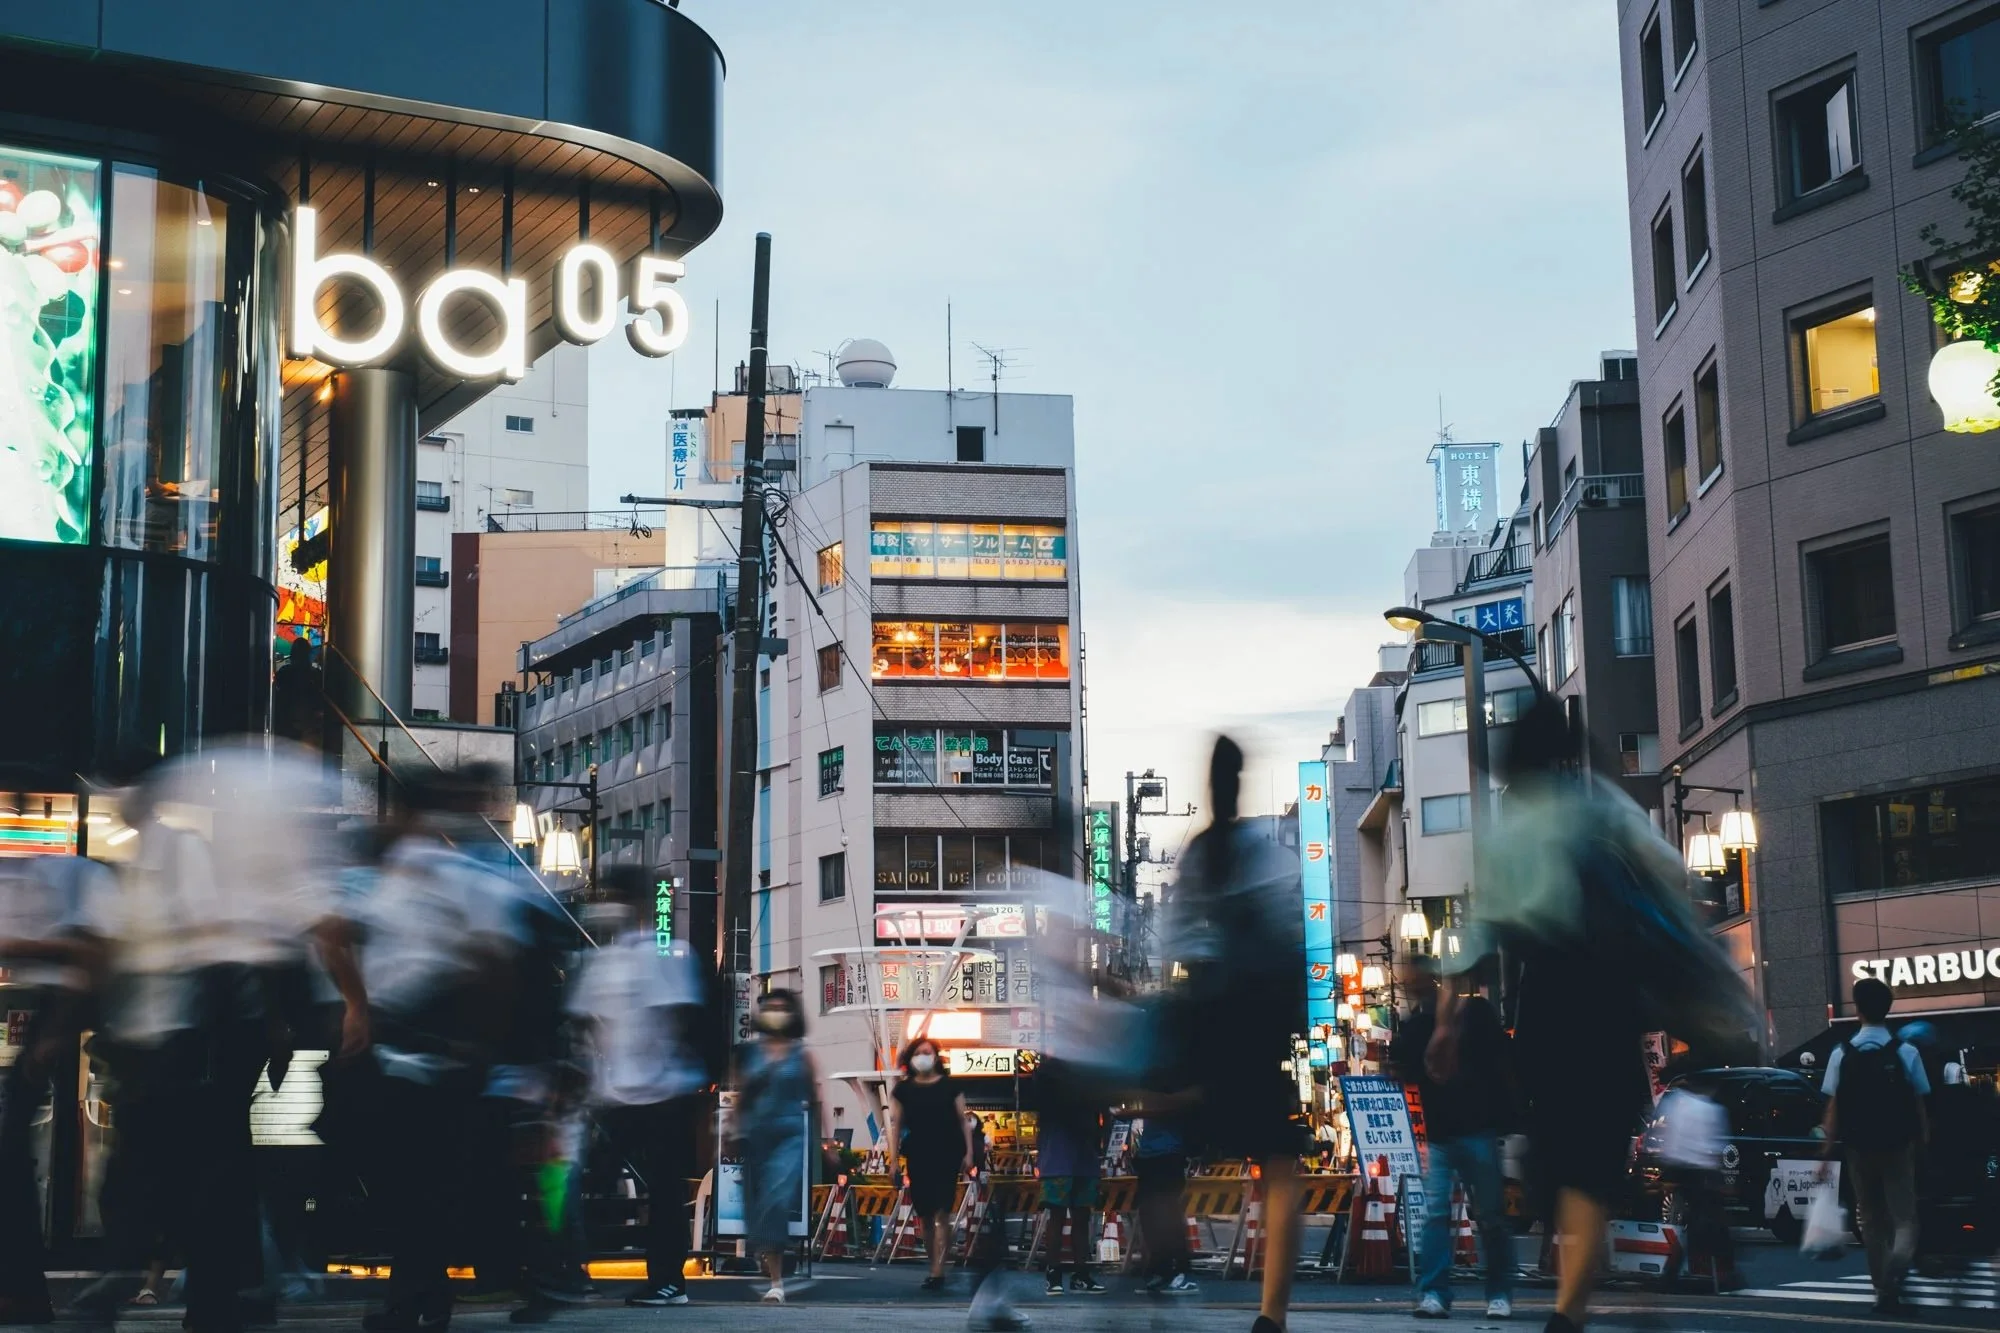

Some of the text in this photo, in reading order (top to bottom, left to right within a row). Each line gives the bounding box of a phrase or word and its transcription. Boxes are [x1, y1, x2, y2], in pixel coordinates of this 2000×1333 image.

[673, 432, 688, 490] 医療ビル
[1450, 452, 1489, 460] HOTEL
[976, 753, 1003, 766] Body
[1008, 754, 1033, 764] Care
[950, 872, 970, 884] DE
[979, 961, 993, 995] 時計
[1364, 1130, 1403, 1144] をしています
